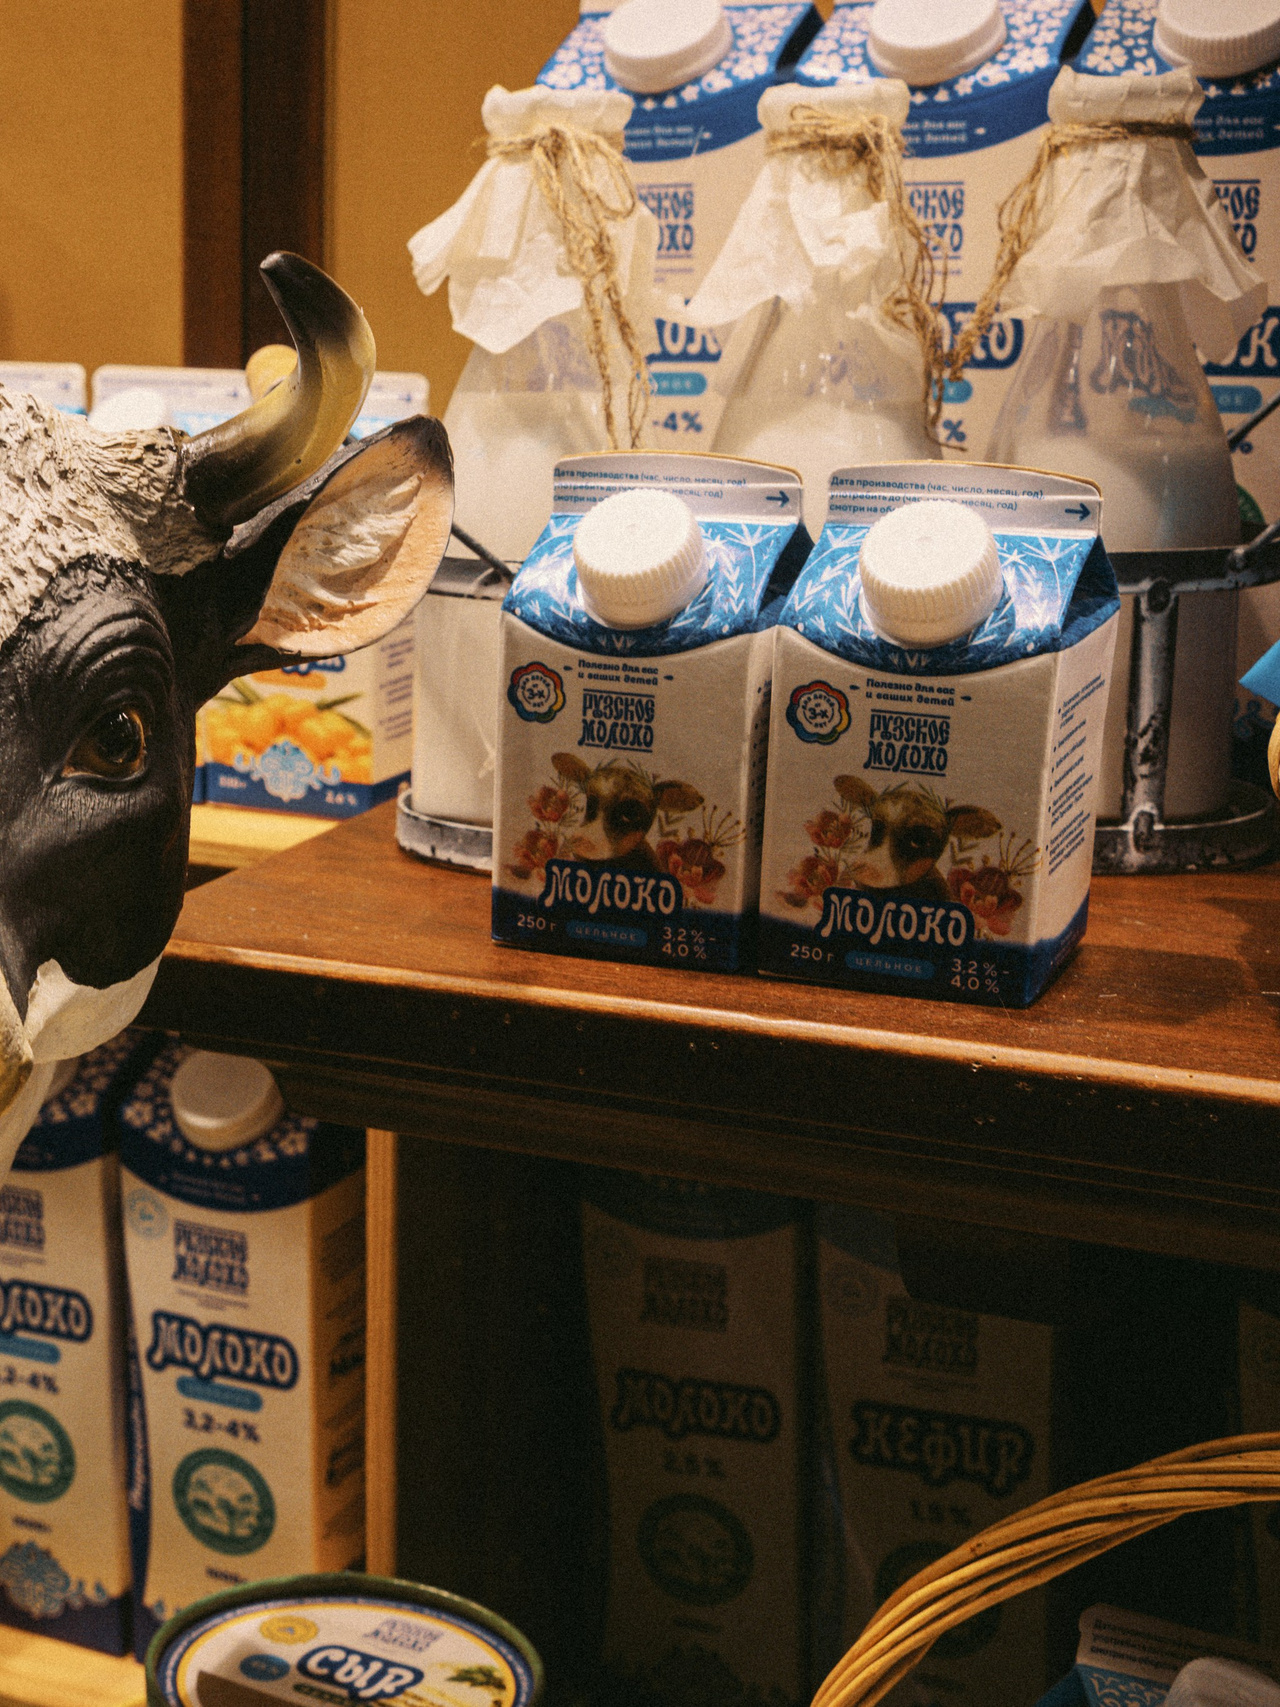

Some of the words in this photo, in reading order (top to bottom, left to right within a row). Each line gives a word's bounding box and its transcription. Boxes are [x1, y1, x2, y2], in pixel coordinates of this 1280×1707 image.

[577, 470, 639, 480] производства
[830, 476, 855, 487] Дата
[856, 479, 926, 490] производства
[829, 503, 865, 513] смотри
[997, 501, 1018, 511] год)
[578, 659, 620, 671] Полезно
[622, 663, 640, 673] для
[641, 666, 659, 675] вас
[588, 673, 620, 682] ваших
[624, 674, 658, 686] детей
[866, 678, 913, 691] Полезно
[915, 682, 935, 694] для
[936, 685, 956, 695] вас
[865, 691, 873, 699] и
[876, 692, 913, 703] ваших
[916, 694, 955, 707] детей
[582, 693, 656, 723] РУЗСКОЕ
[577, 718, 654, 749] МОЛОКО
[870, 713, 951, 746] РУЗСКОЕ
[862, 740, 948, 773] МОЛОКО
[544, 864, 676, 915] МОЛОКО
[517, 913, 546, 931] 250
[550, 921, 557, 933] г
[820, 893, 967, 947] МОЛОКО
[575, 925, 637, 942] ЦЕЛЬНОЕ
[662, 926, 687, 942] 3,2
[662, 943, 689, 958] 4,0
[790, 943, 823, 961] 250
[827, 952, 835, 963] г
[854, 956, 922, 974] ЦЕЛЬНОЕ
[951, 958, 978, 975] 3,2
[950, 974, 980, 991] 4,0
[152, 1317, 295, 1385] МОЛОКО
[306, 1647, 416, 1699] СЫР
